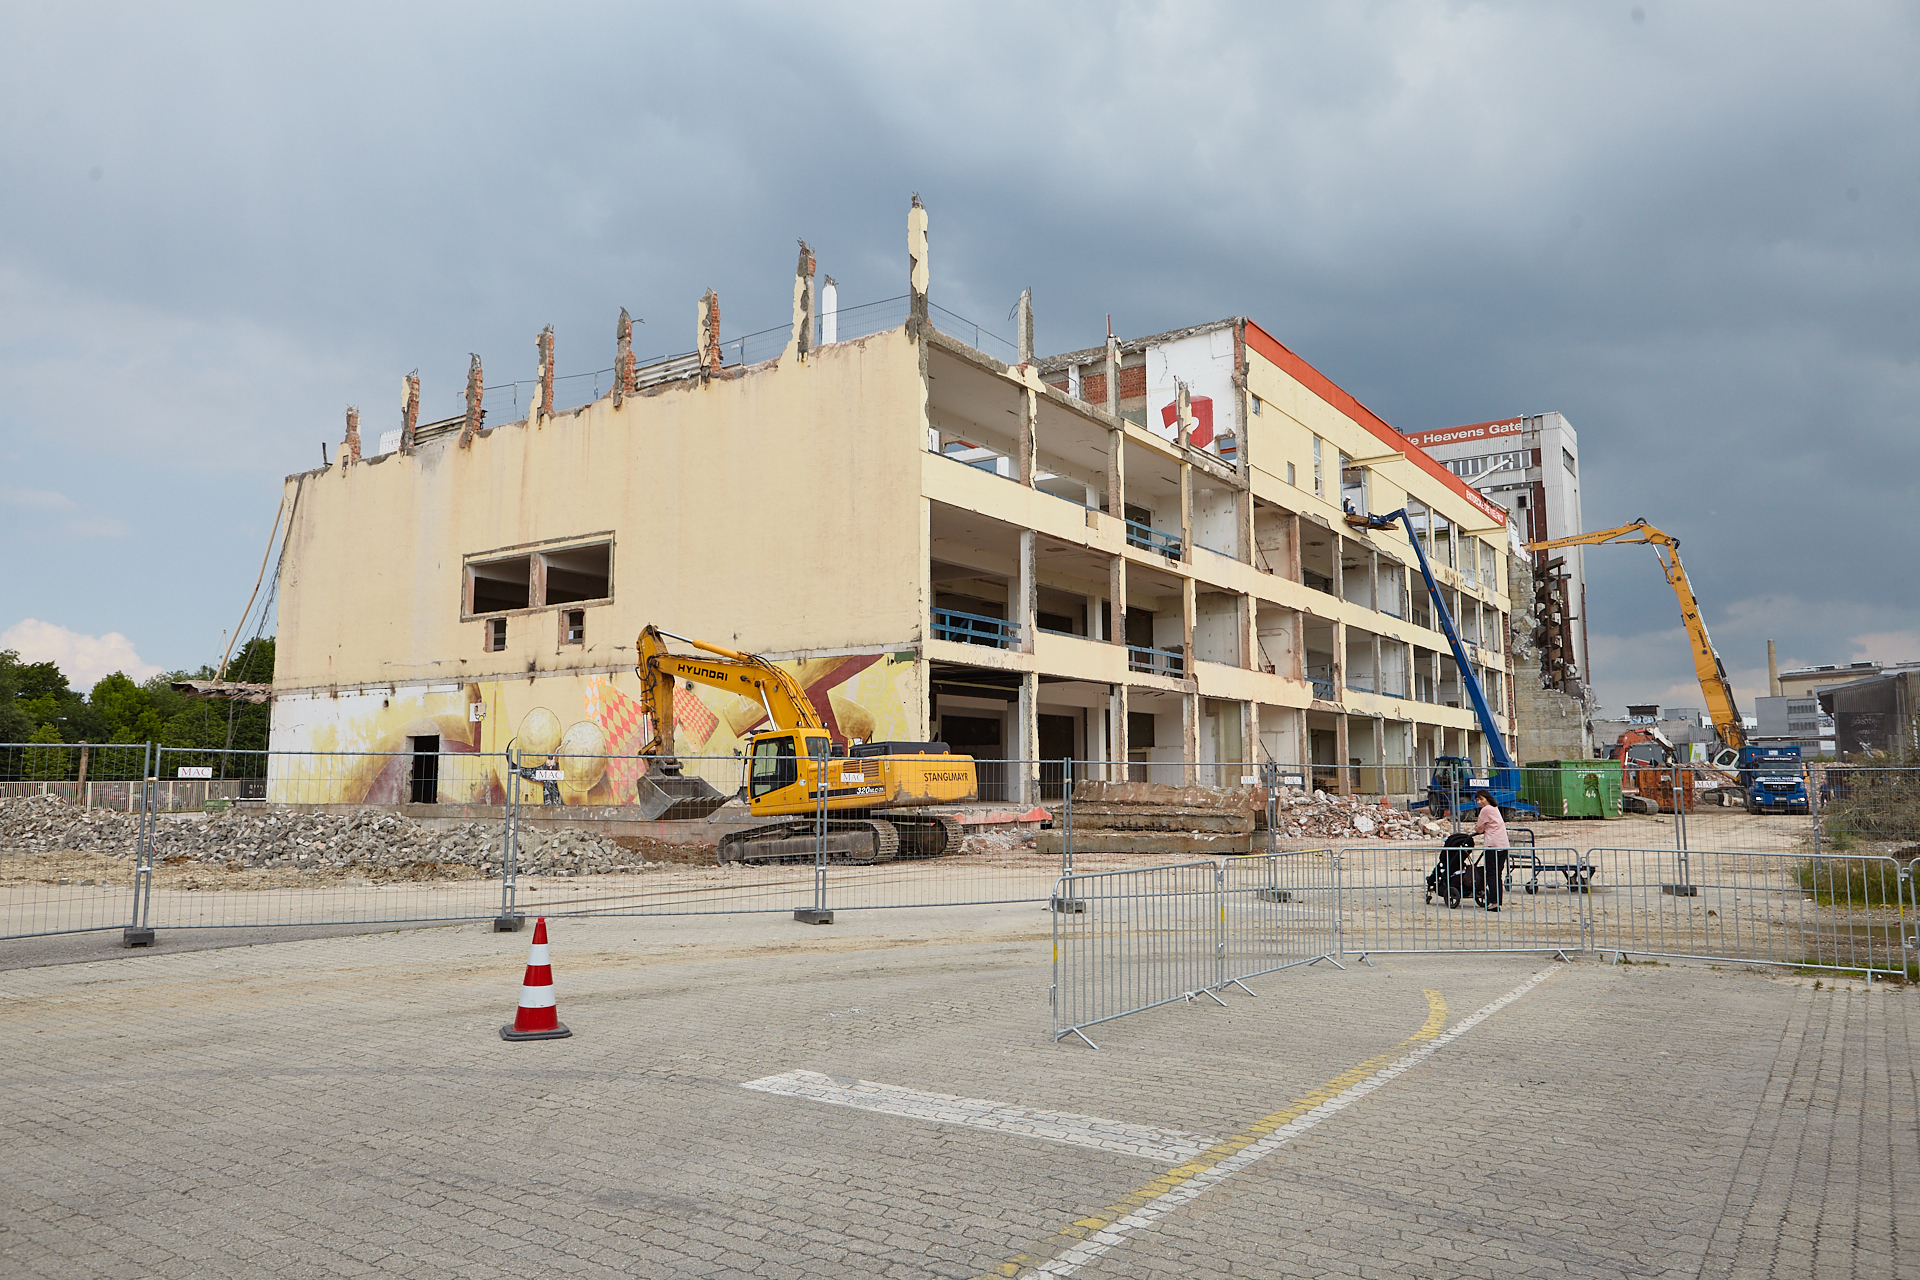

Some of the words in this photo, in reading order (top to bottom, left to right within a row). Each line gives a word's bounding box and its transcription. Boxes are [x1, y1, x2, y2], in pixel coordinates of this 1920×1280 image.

[1423, 428, 1485, 444] Heavens
[1489, 422, 1522, 434] Gate
[677, 663, 728, 682] HYUNDAI
[181, 768, 209, 777] MAC
[538, 771, 562, 779] MAC
[843, 773, 864, 781] MAC
[923, 772, 969, 782] STANGLMAYR
[1585, 790, 1597, 798] 44
